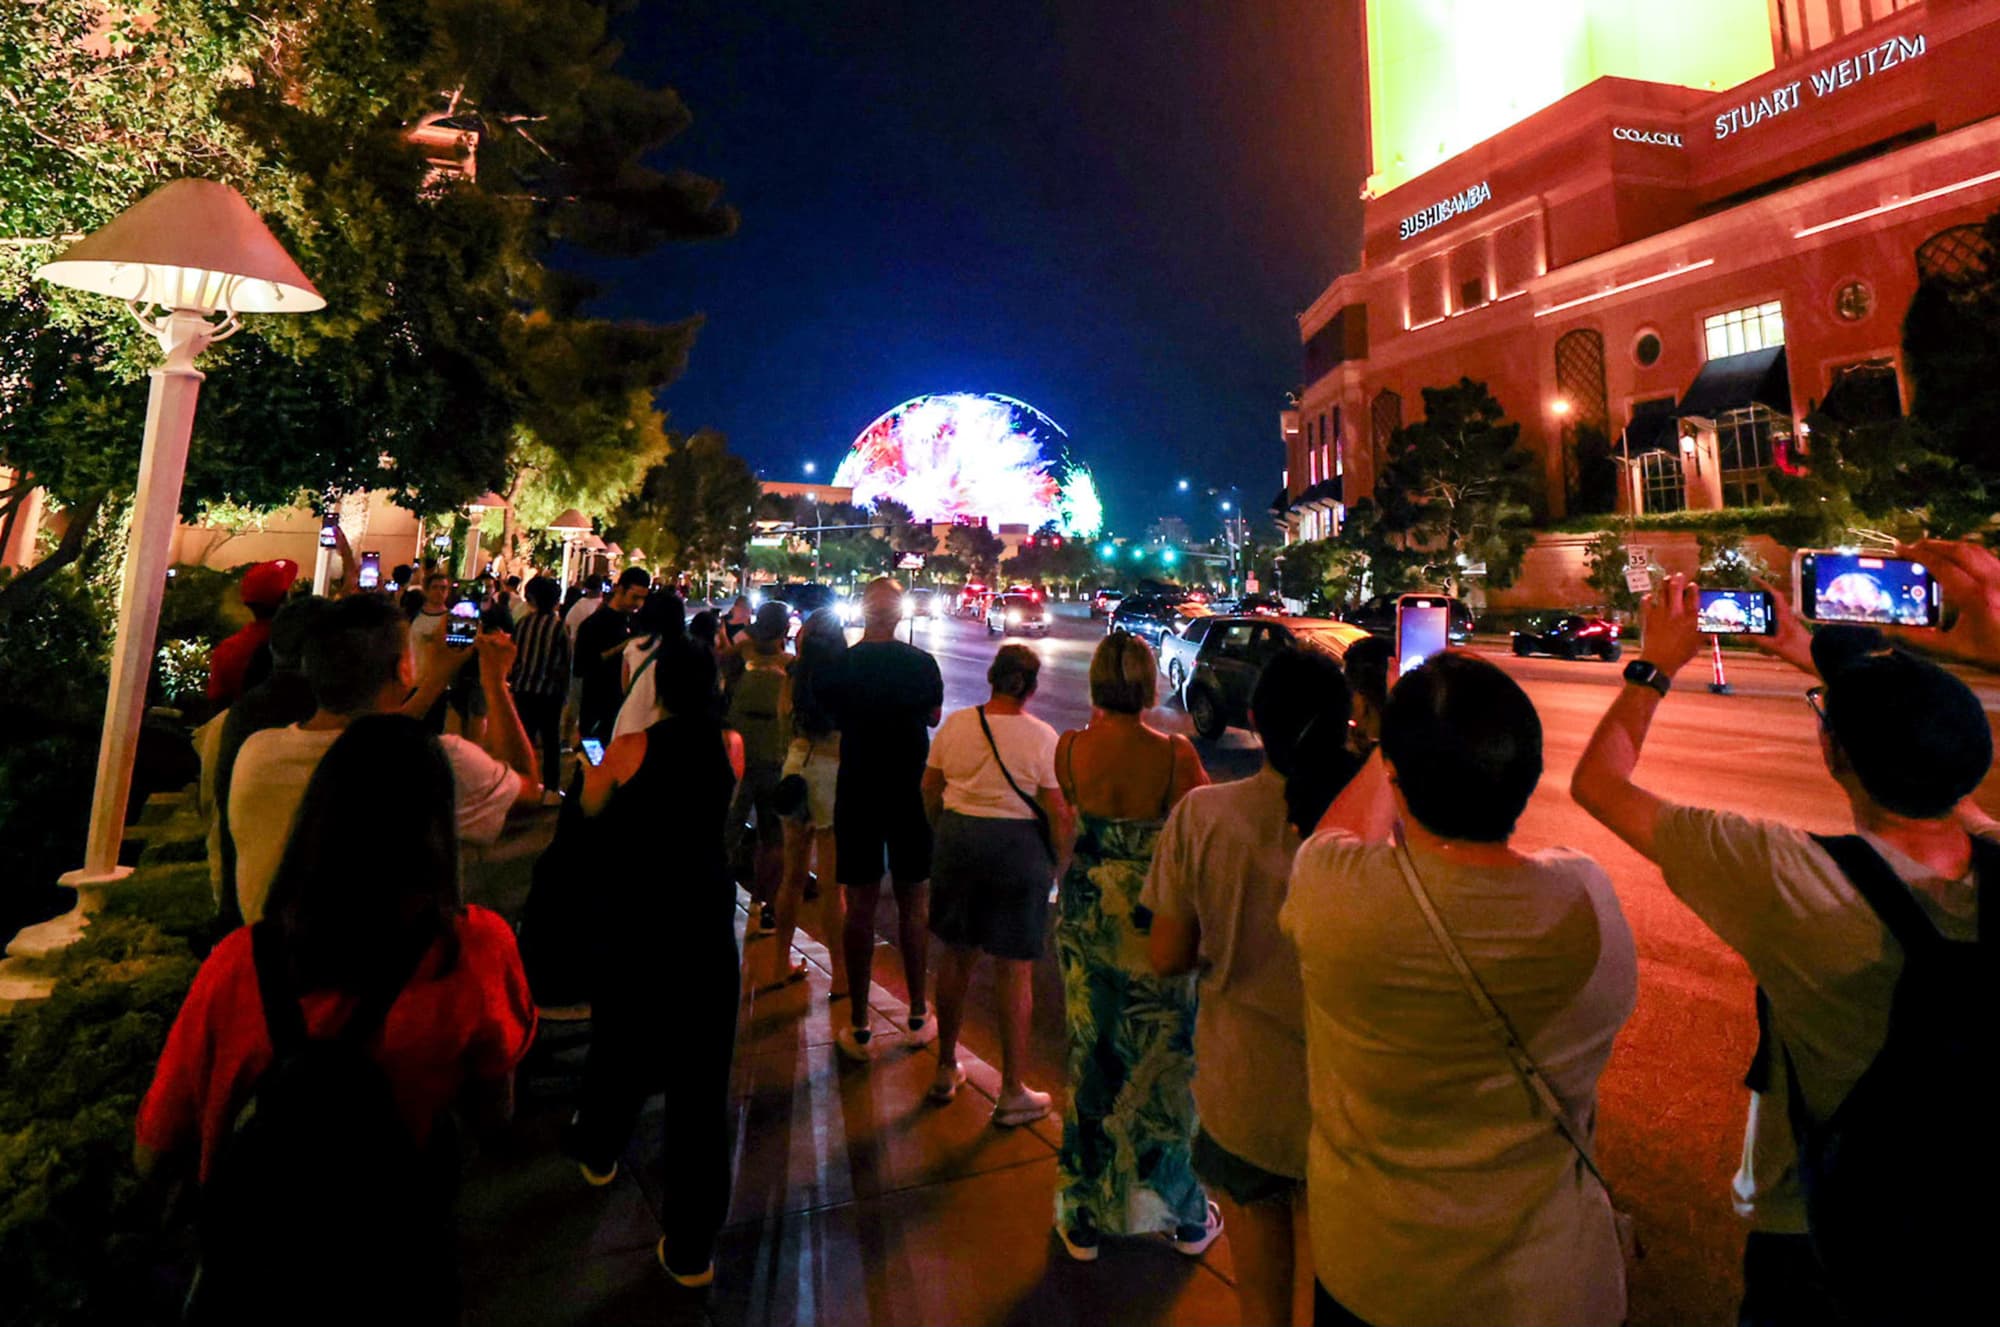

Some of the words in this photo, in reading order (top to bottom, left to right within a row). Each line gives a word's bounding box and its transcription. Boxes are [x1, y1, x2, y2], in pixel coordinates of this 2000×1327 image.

[1714, 81, 1801, 140] STUART
[1810, 34, 1926, 97] WEITZM
[1612, 126, 1684, 148] COACH
[1399, 180, 1492, 240] SUSHISAMBA
[1631, 555, 1646, 565] 35
